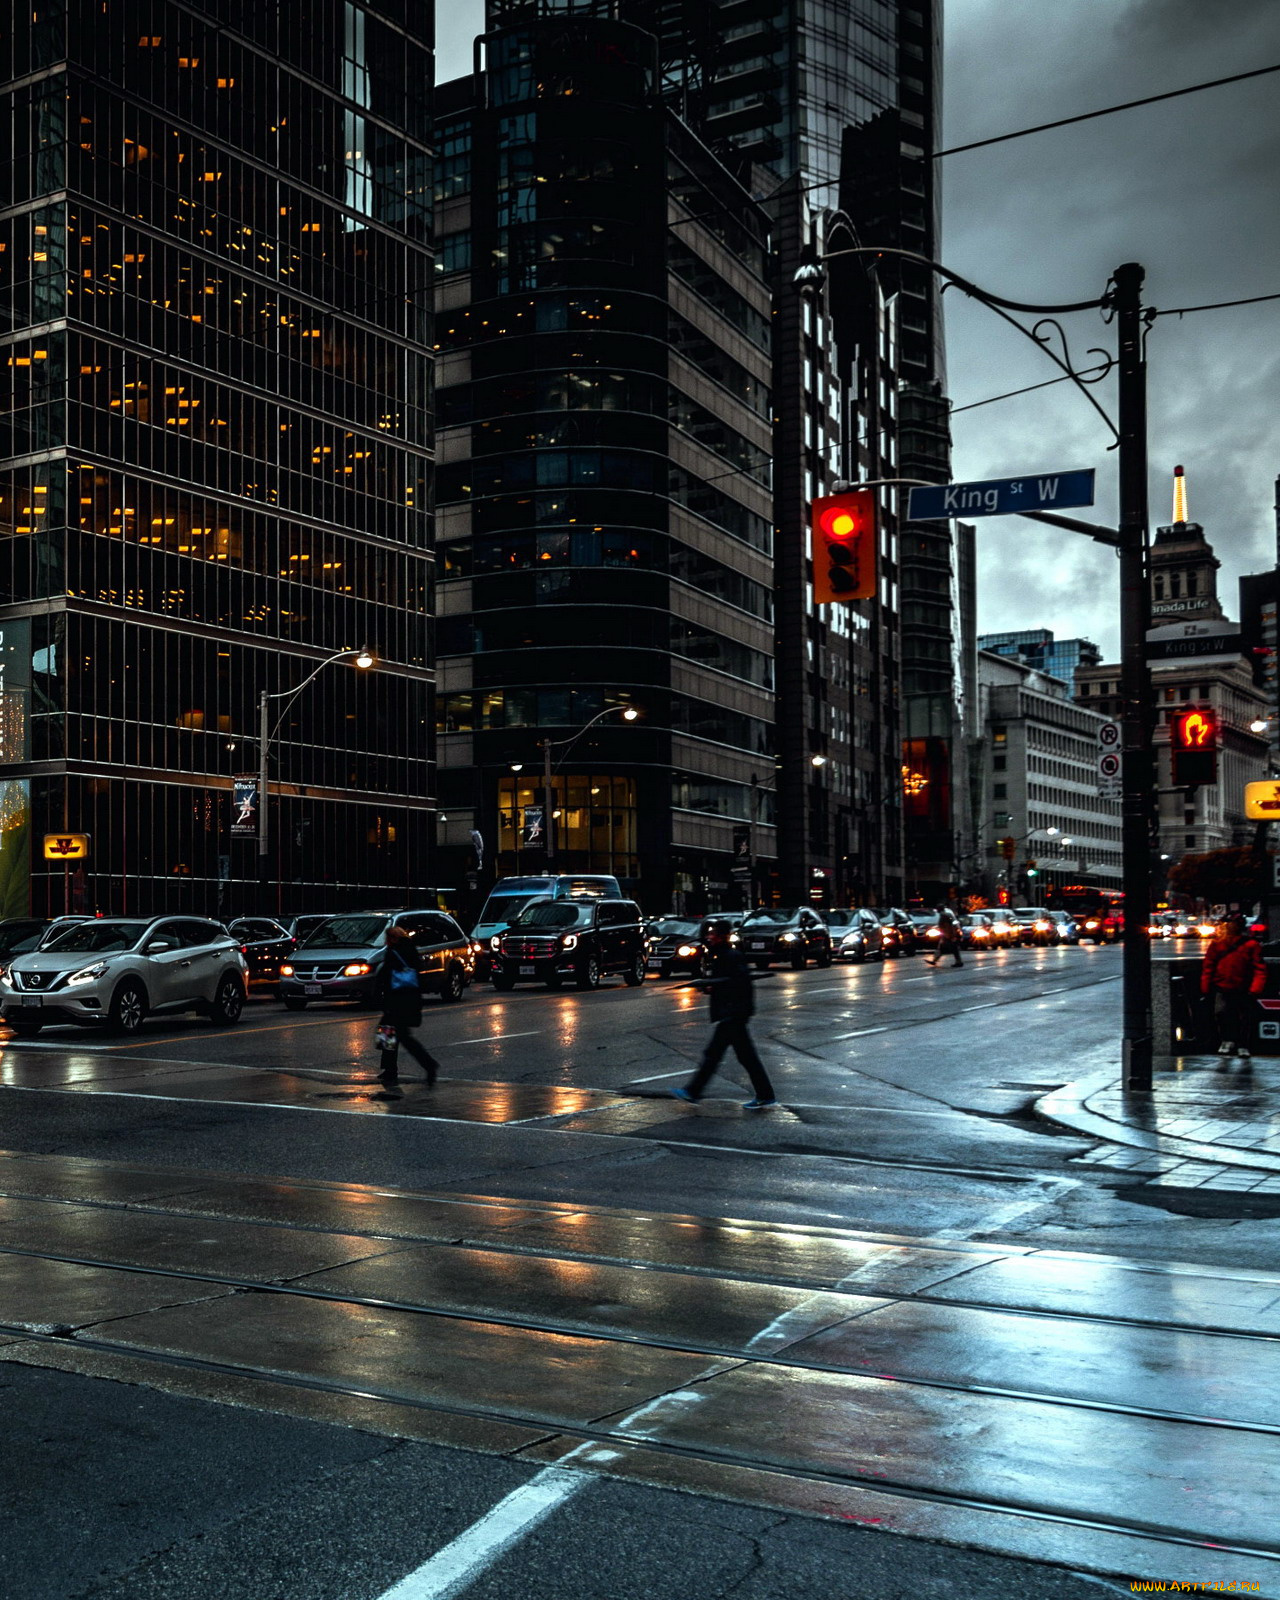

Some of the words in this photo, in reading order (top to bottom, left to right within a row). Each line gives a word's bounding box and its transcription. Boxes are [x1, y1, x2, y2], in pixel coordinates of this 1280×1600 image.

[943, 486, 999, 512] King
[1010, 481, 1024, 494] St
[1037, 477, 1060, 501] W
[1151, 602, 1186, 614] anada
[1187, 599, 1209, 610] Life
[1165, 641, 1196, 654] King
[1200, 643, 1210, 651] St
[1213, 639, 1225, 650] W
